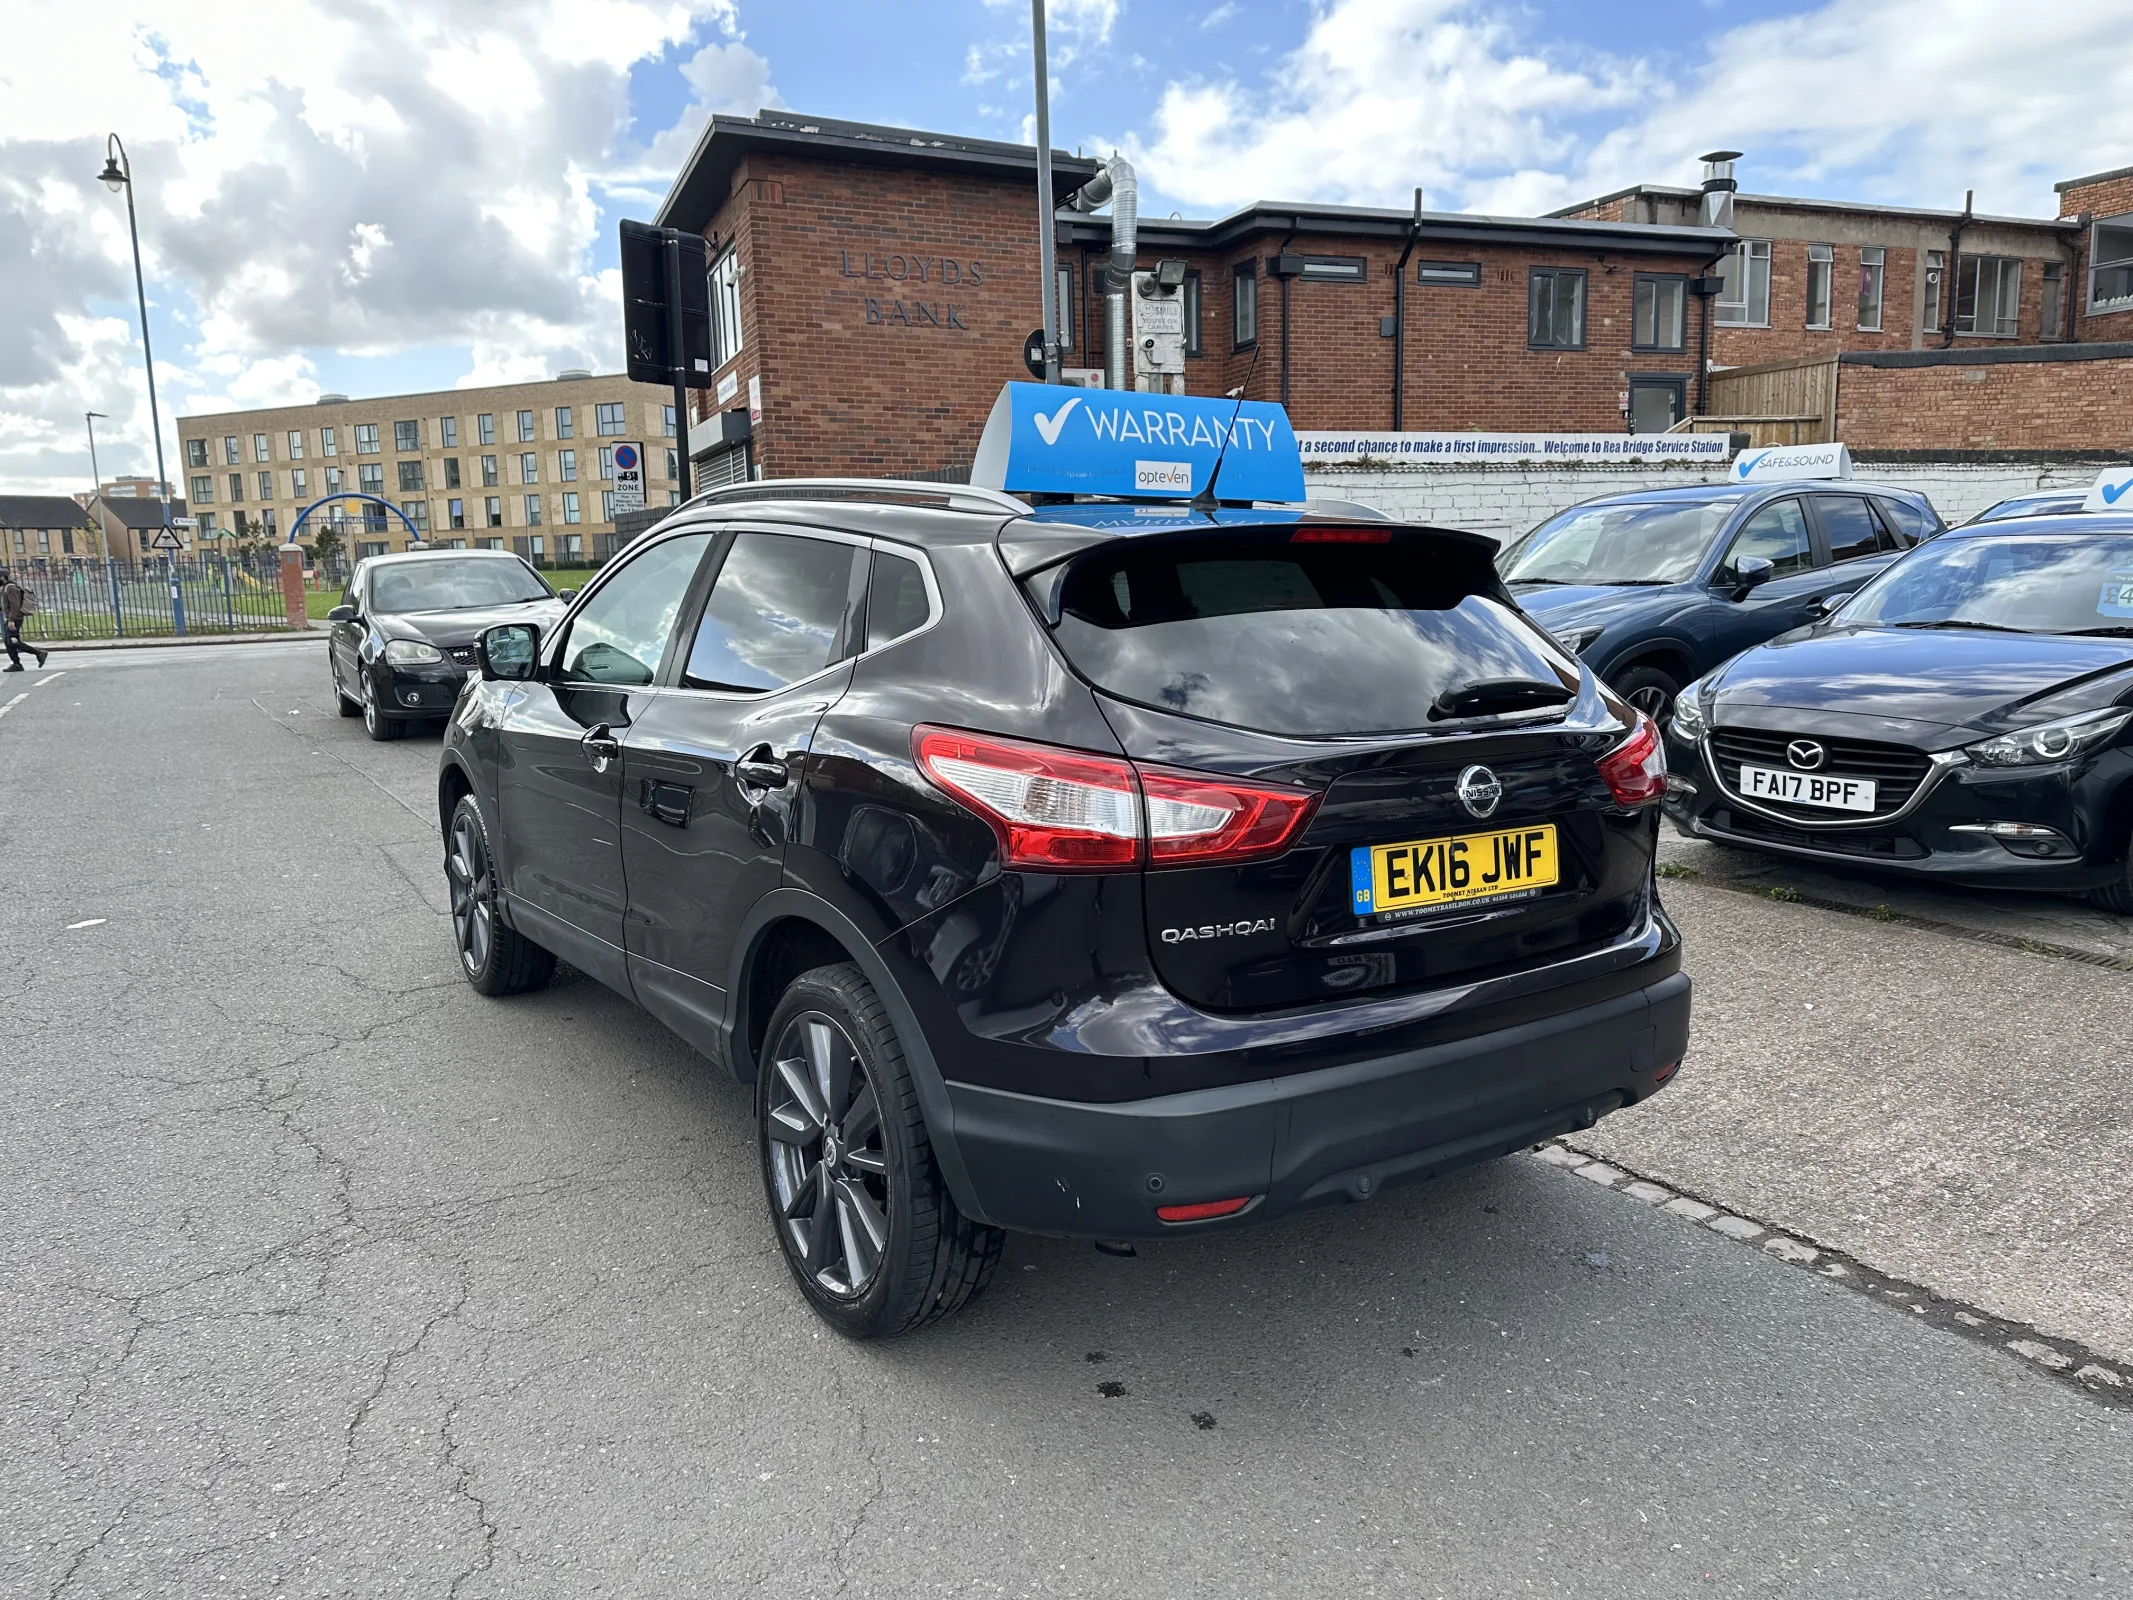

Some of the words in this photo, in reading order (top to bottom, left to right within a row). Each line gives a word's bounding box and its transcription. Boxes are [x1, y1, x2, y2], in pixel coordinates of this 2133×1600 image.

[843, 249, 983, 286] LLOYDS
[865, 297, 969, 330] BANK
[1084, 405, 1276, 452] WARRANTY
[1304, 441, 1311, 453] a
[1314, 440, 1356, 453] second
[1357, 440, 1398, 453] chance
[1400, 440, 1412, 453] to
[1413, 440, 1443, 453] make
[1444, 441, 1452, 453] a
[1453, 440, 1476, 453] first
[1477, 440, 1542, 454] impression...
[1544, 441, 1590, 454] Welcome
[1591, 441, 1601, 453] to
[1603, 441, 1620, 453] Rea
[1622, 441, 1653, 454] Bridge
[1655, 441, 1690, 453] Service
[1691, 441, 1723, 453] Station
[1758, 454, 1834, 468] SAFE&SOUND
[1138, 466, 1189, 485] opteven
[1463, 784, 1500, 799] NISSAN
[1753, 771, 1802, 798] FA17
[1810, 779, 1859, 804] BPF
[1387, 842, 1470, 898] EK16
[1481, 832, 1544, 884] JWF
[1356, 889, 1370, 903] GB
[1442, 890, 1466, 898] TOOMEY
[1467, 887, 1487, 896] NISSAN
[1161, 918, 1275, 944] QASHQAI
